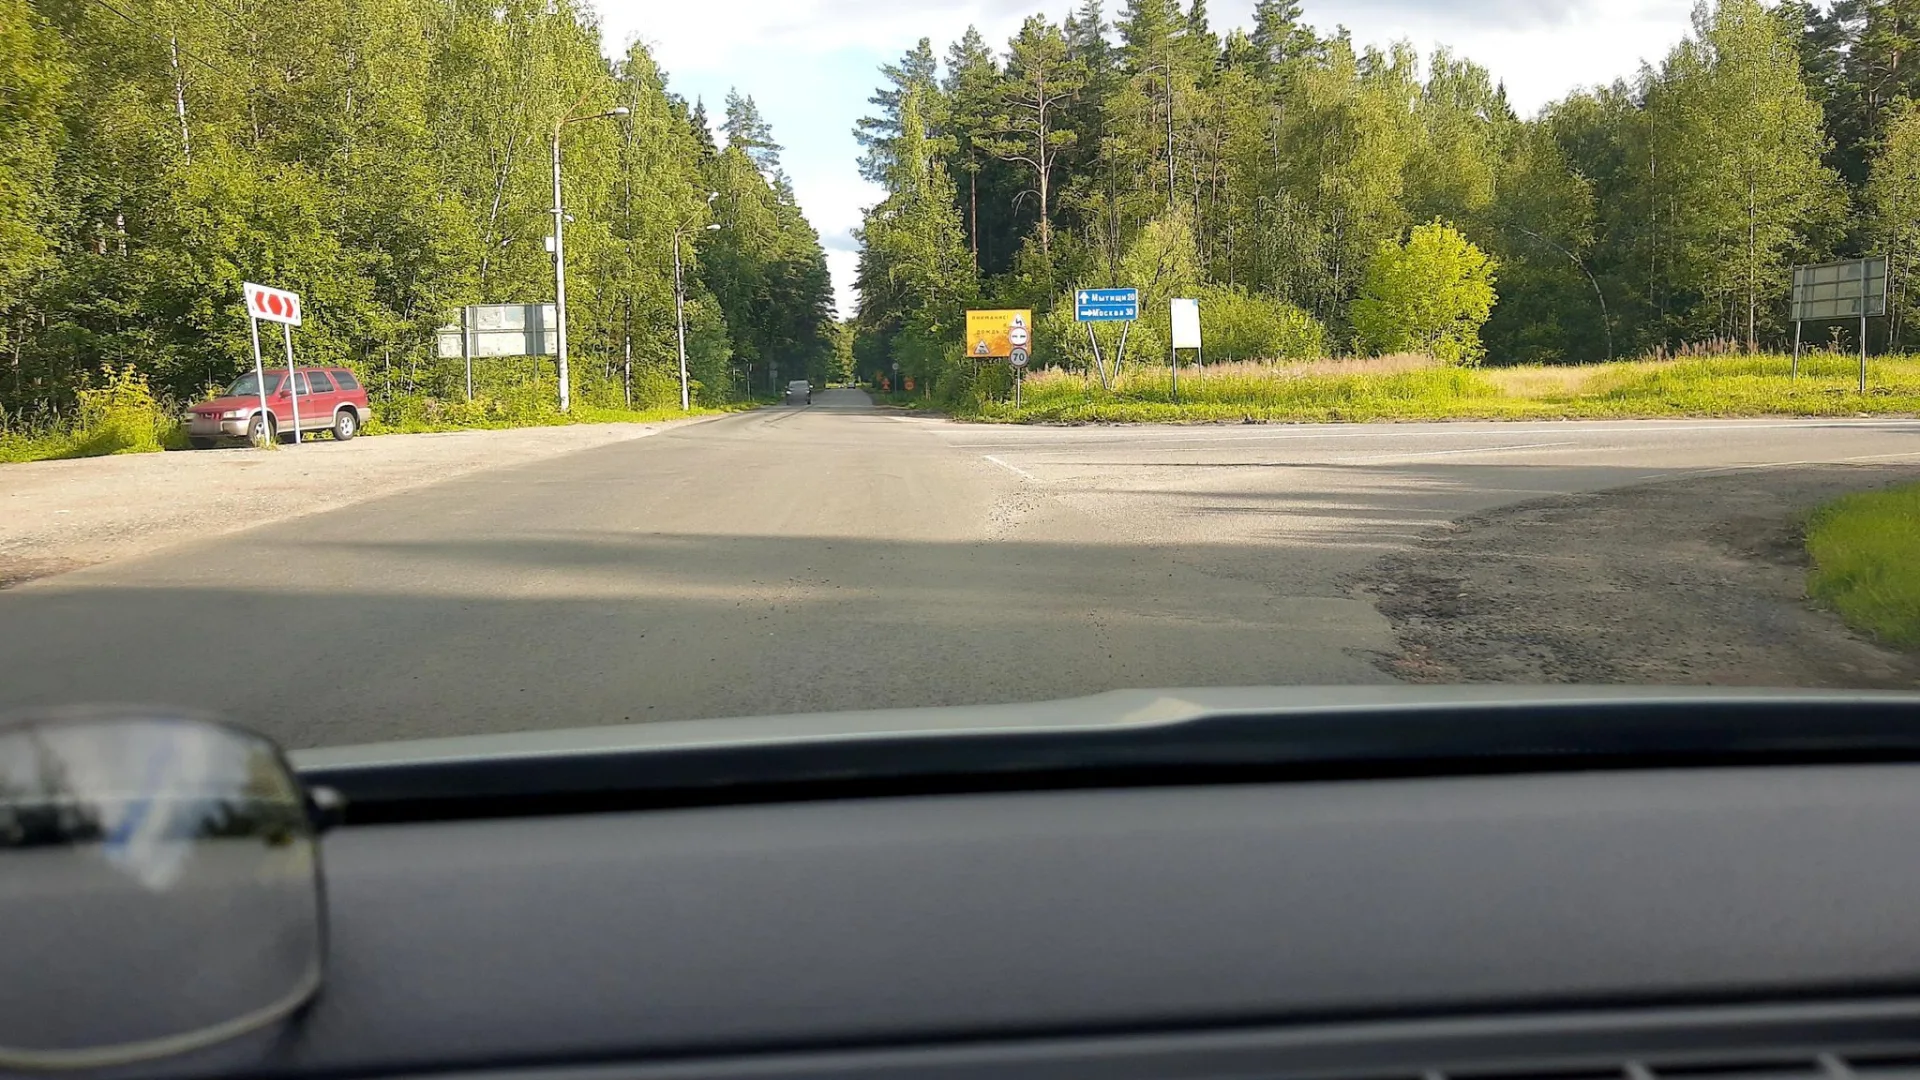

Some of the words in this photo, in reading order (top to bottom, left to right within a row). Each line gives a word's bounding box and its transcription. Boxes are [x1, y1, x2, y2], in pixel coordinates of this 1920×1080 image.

[1091, 293, 1126, 302] Мытищи
[1127, 292, 1135, 301] 20
[1092, 308, 1124, 316] Москва
[1012, 352, 1025, 361] 70
